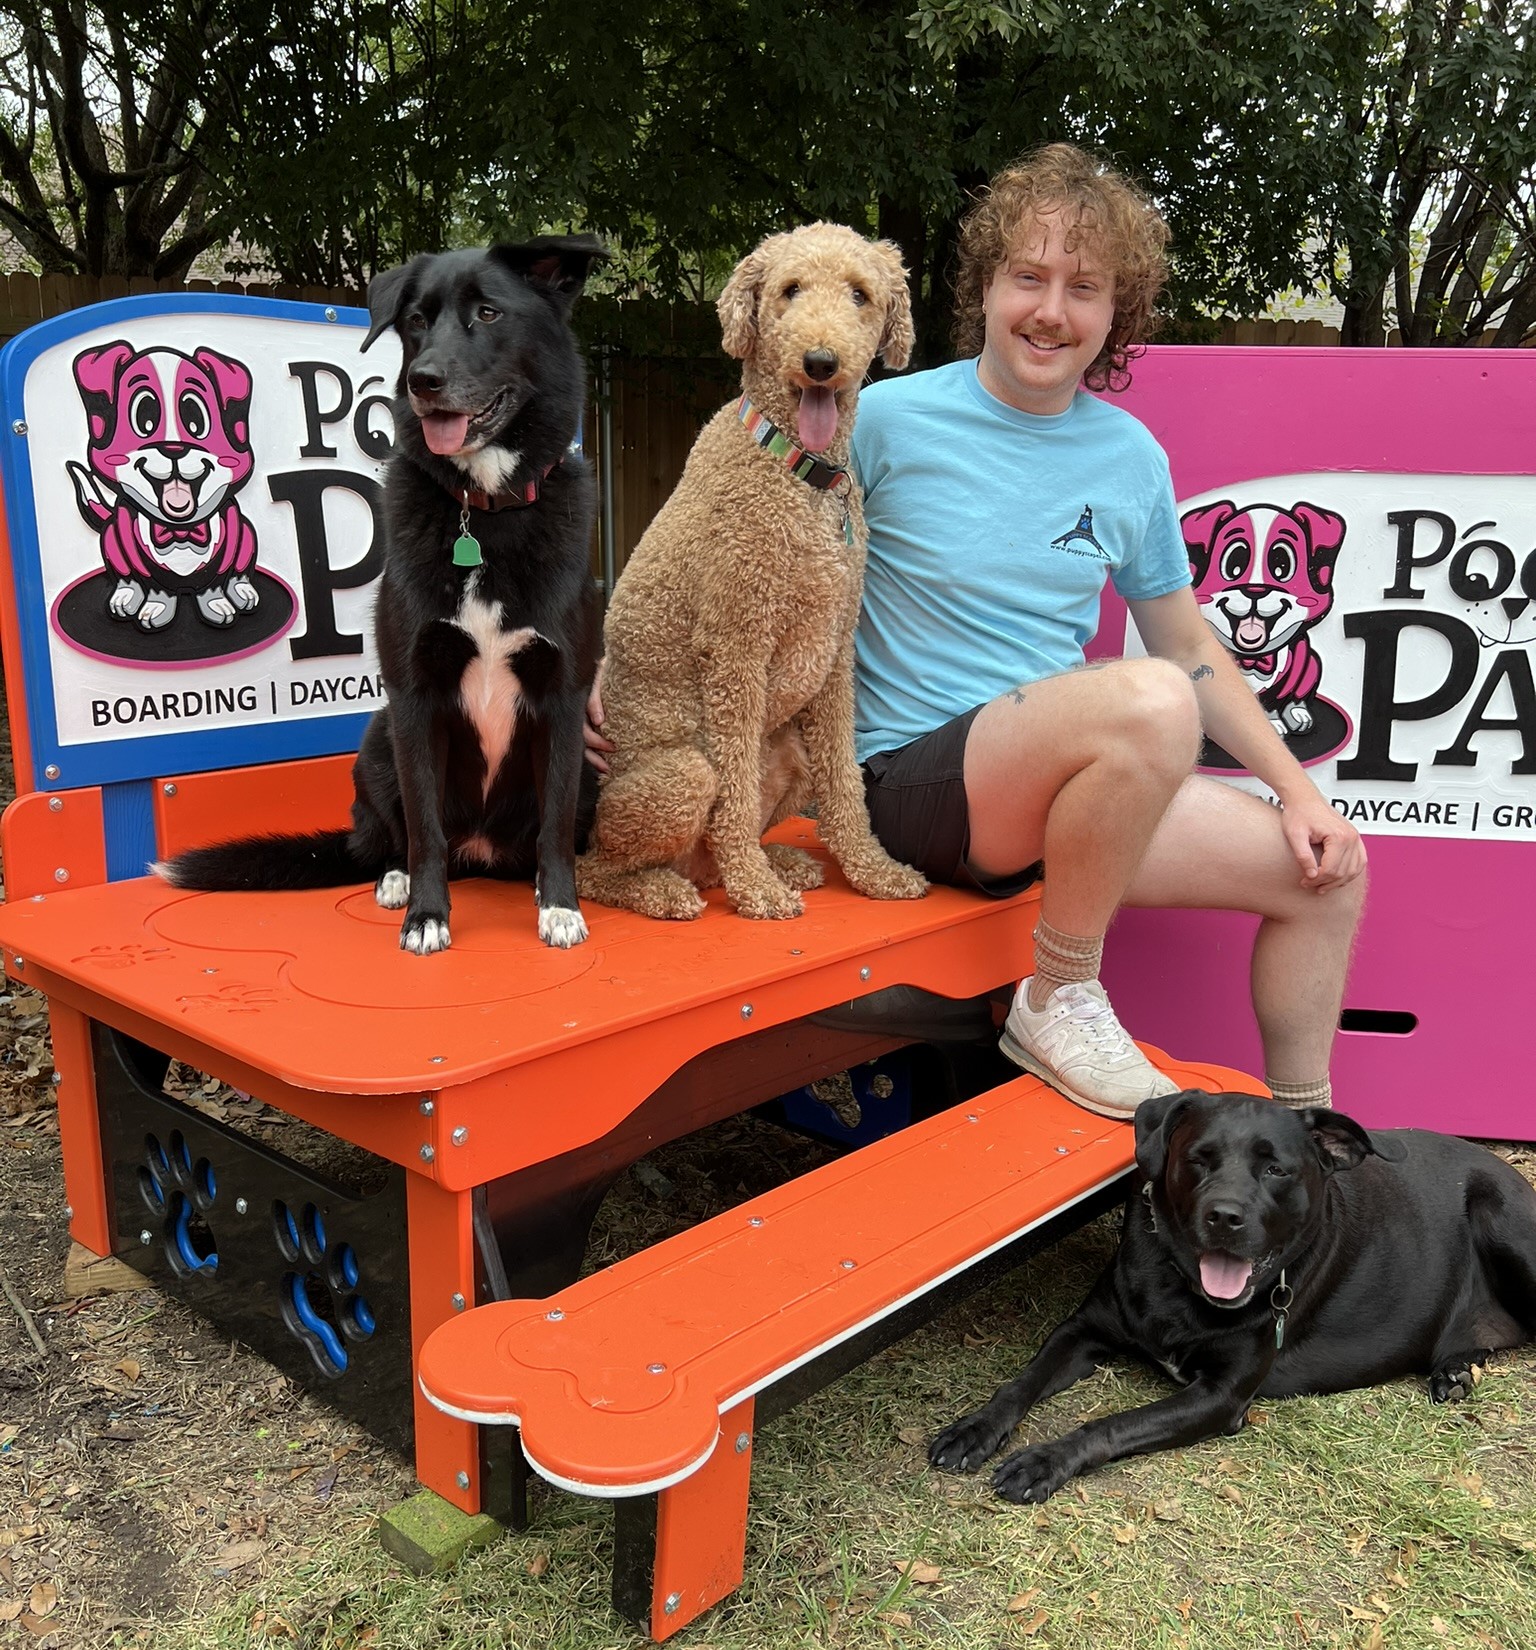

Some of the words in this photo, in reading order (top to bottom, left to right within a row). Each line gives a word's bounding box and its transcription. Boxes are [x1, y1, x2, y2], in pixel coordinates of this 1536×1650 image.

[1383, 509, 1536, 601] PO
[91, 685, 257, 727] BOARDING
[1331, 799, 1459, 825] DAYCARE
[1492, 805, 1536, 828] GR
